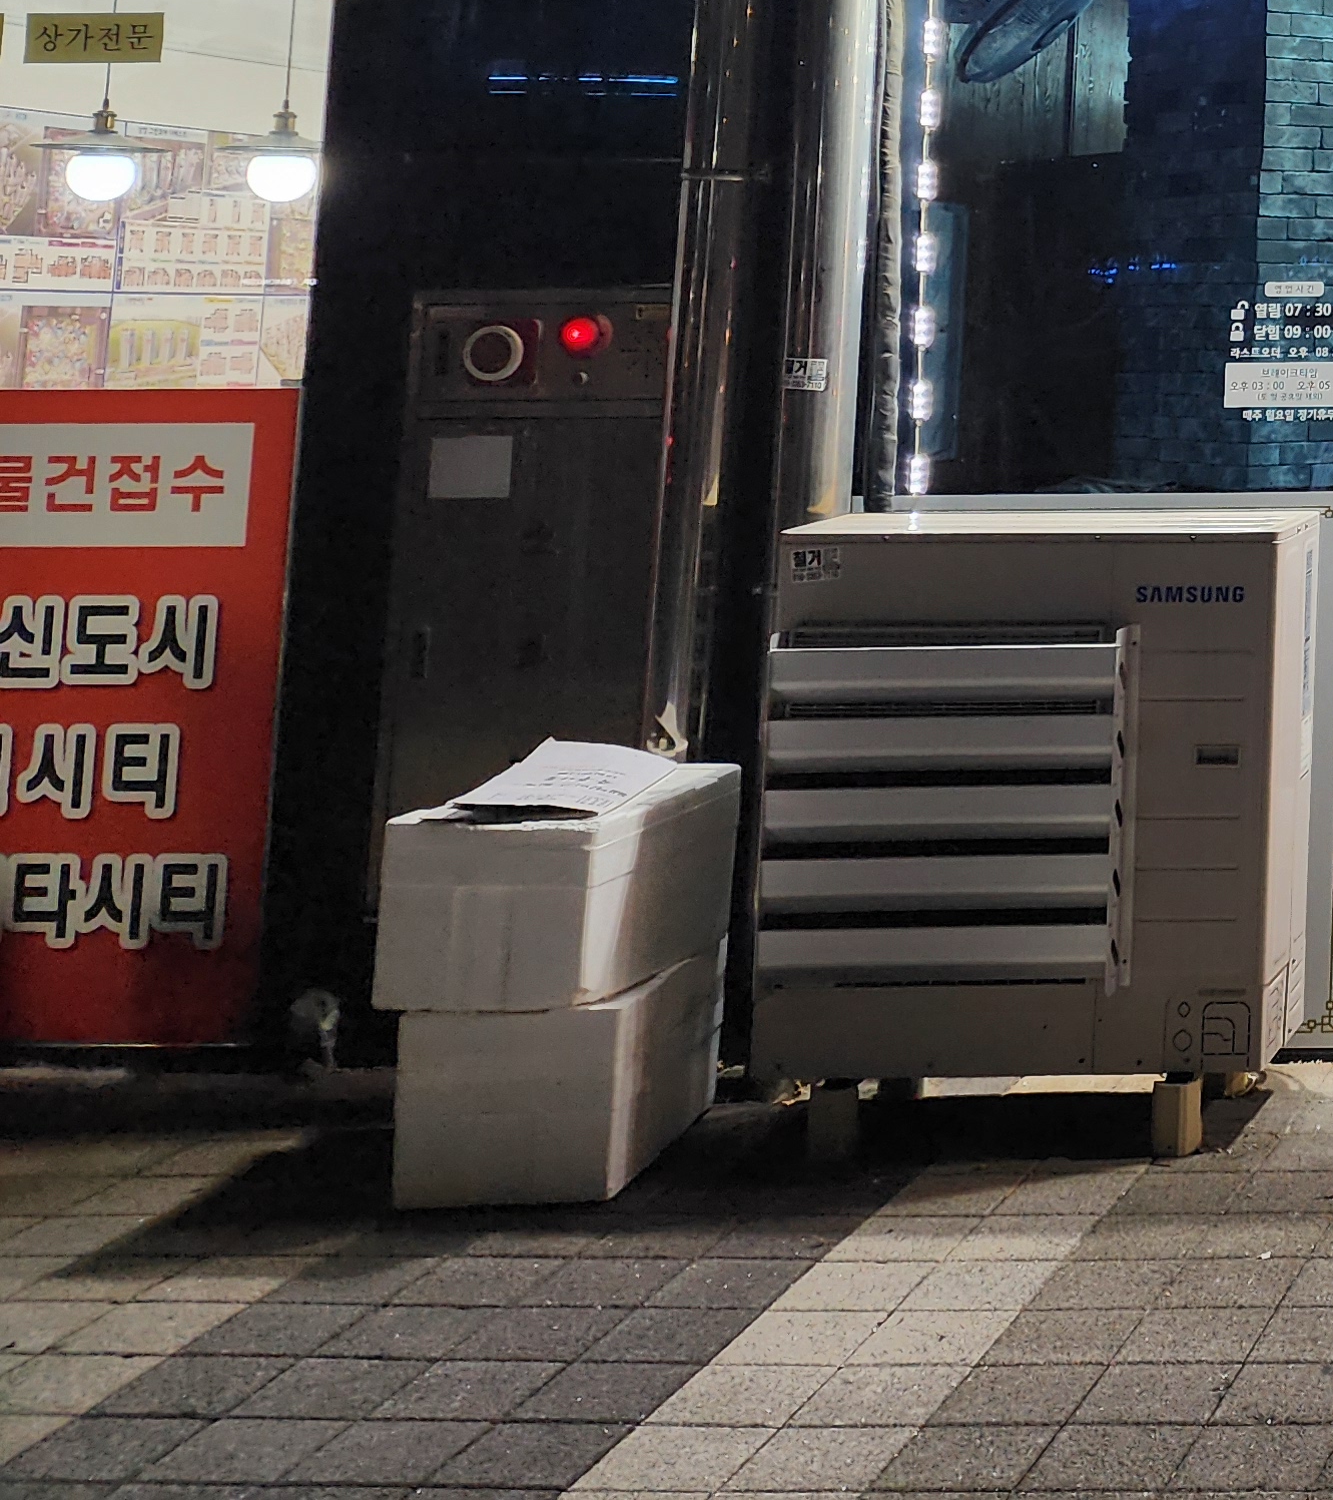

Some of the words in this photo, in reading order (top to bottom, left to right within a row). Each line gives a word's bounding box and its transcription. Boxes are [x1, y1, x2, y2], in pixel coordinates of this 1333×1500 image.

[34, 22, 155, 53] 상가전문
[1275, 284, 1315, 295] 영업시간
[1254, 303, 1281, 319] 열림
[1284, 303, 1302, 317] 07
[1314, 303, 1332, 317] 30
[1253, 325, 1280, 341] 닫힘
[1284, 325, 1301, 339] 09
[1313, 325, 1331, 339] 00
[1230, 347, 1281, 359] 라스트오더
[1261, 368, 1318, 379] 브레이크타임
[1135, 585, 1246, 604] SAMSUNG
[0, 730, 174, 813] 시티
